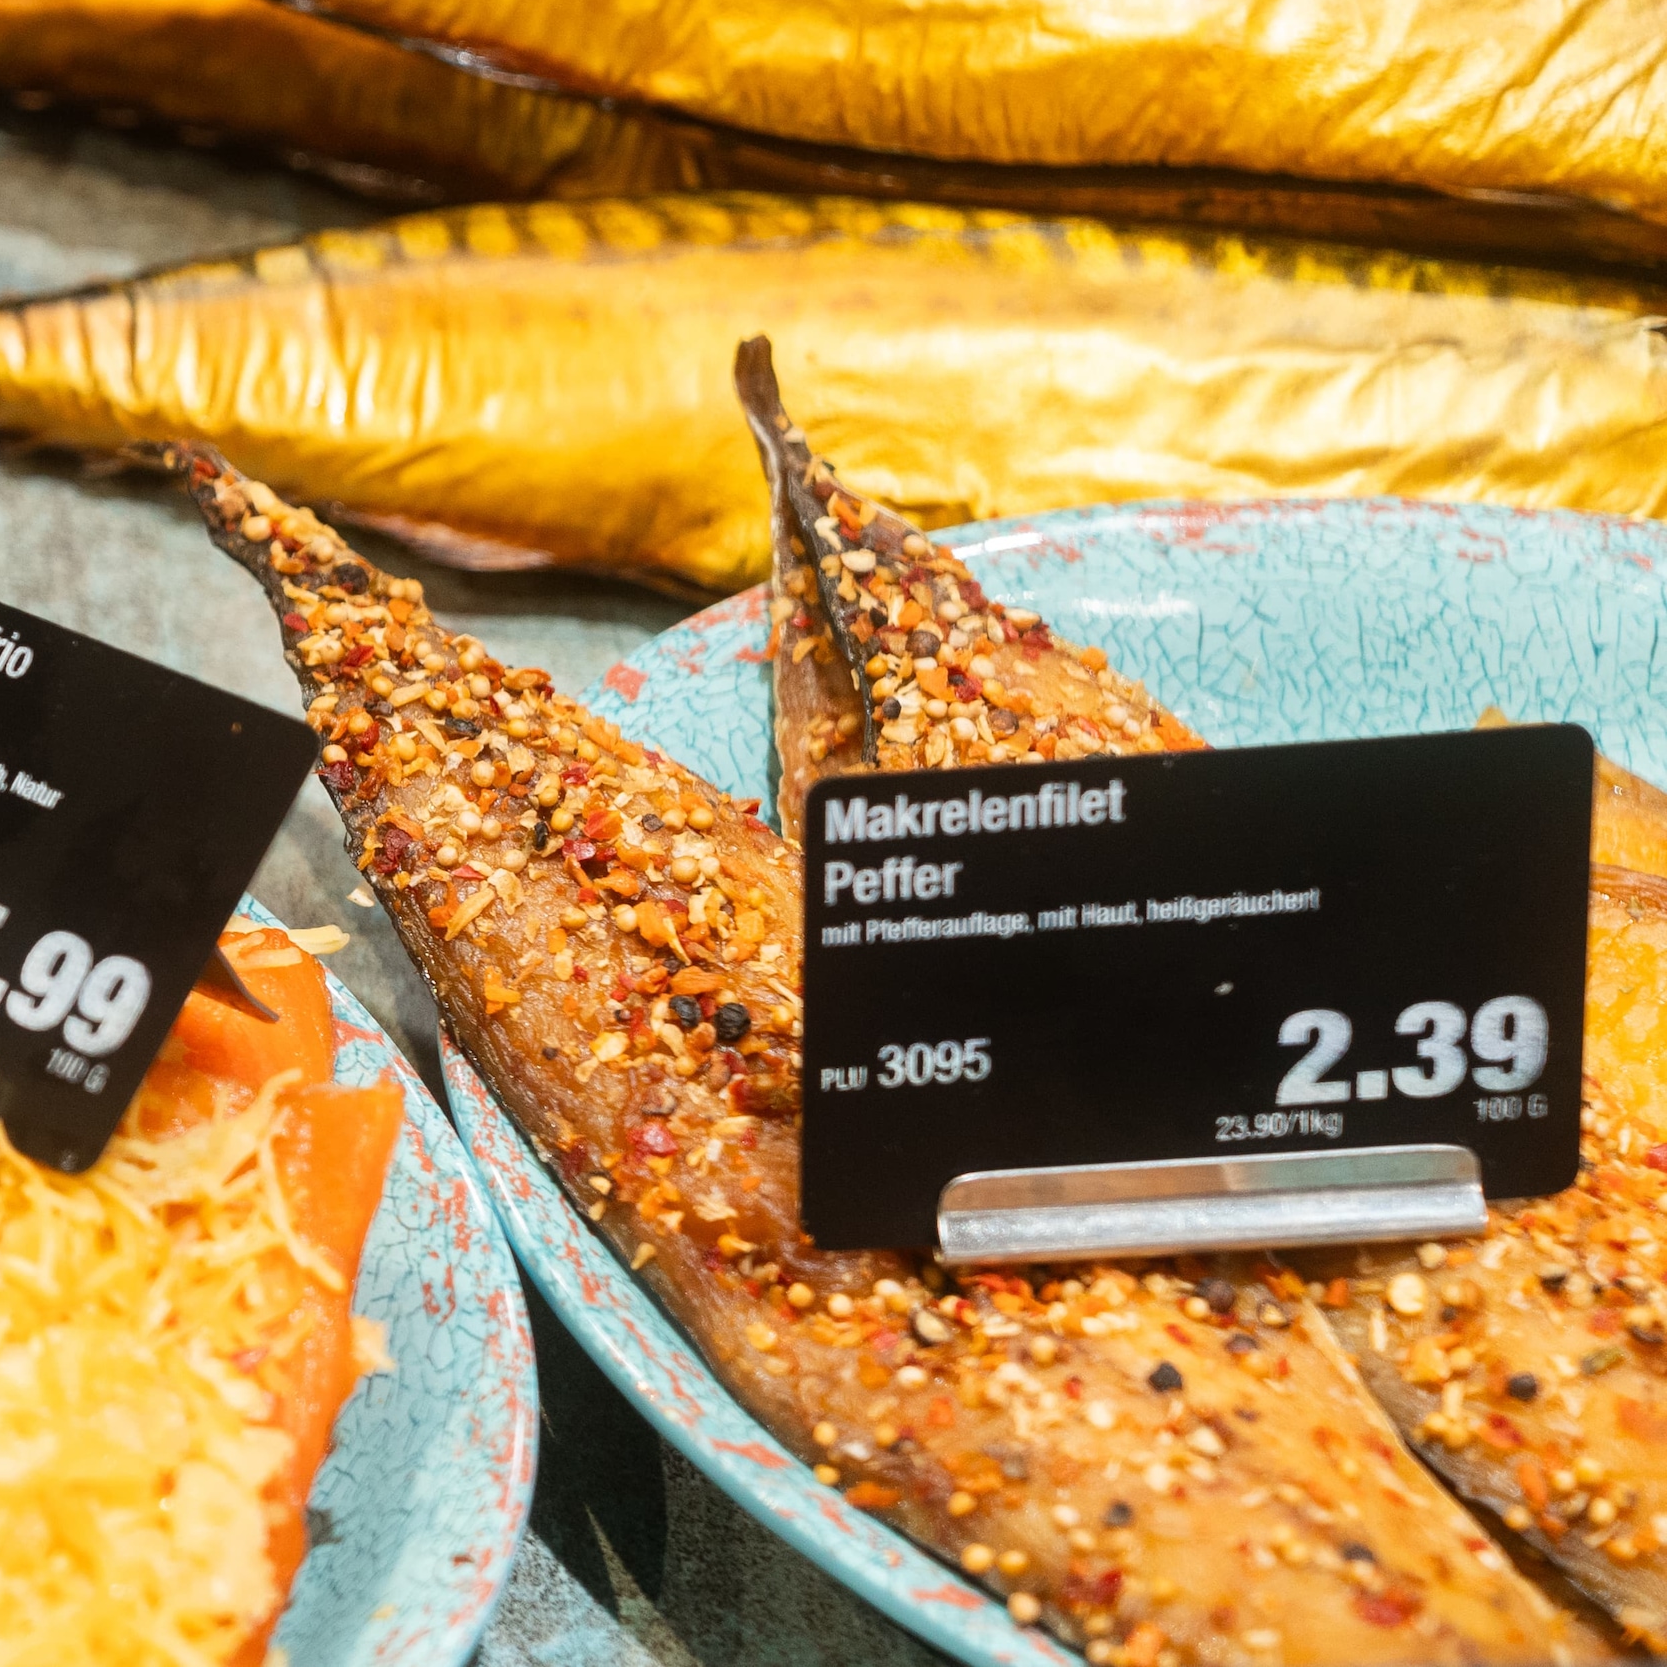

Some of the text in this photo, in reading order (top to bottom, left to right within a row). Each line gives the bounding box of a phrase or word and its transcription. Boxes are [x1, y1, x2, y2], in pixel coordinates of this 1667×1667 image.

[9, 771, 63, 809] Natur
[825, 779, 1127, 844] Makrelenfilet
[824, 855, 963, 905] Peffer
[821, 888, 1320, 946] mit Pfefferauflage, mit Haut, heißgeräuchert
[46, 1048, 109, 1094] 100 G
[820, 1038, 992, 1092] PLU 3095
[1276, 996, 1545, 1105] 2.39
[1215, 1110, 1344, 1142] 23.90/1kg
[1473, 1095, 1523, 1121] 100
